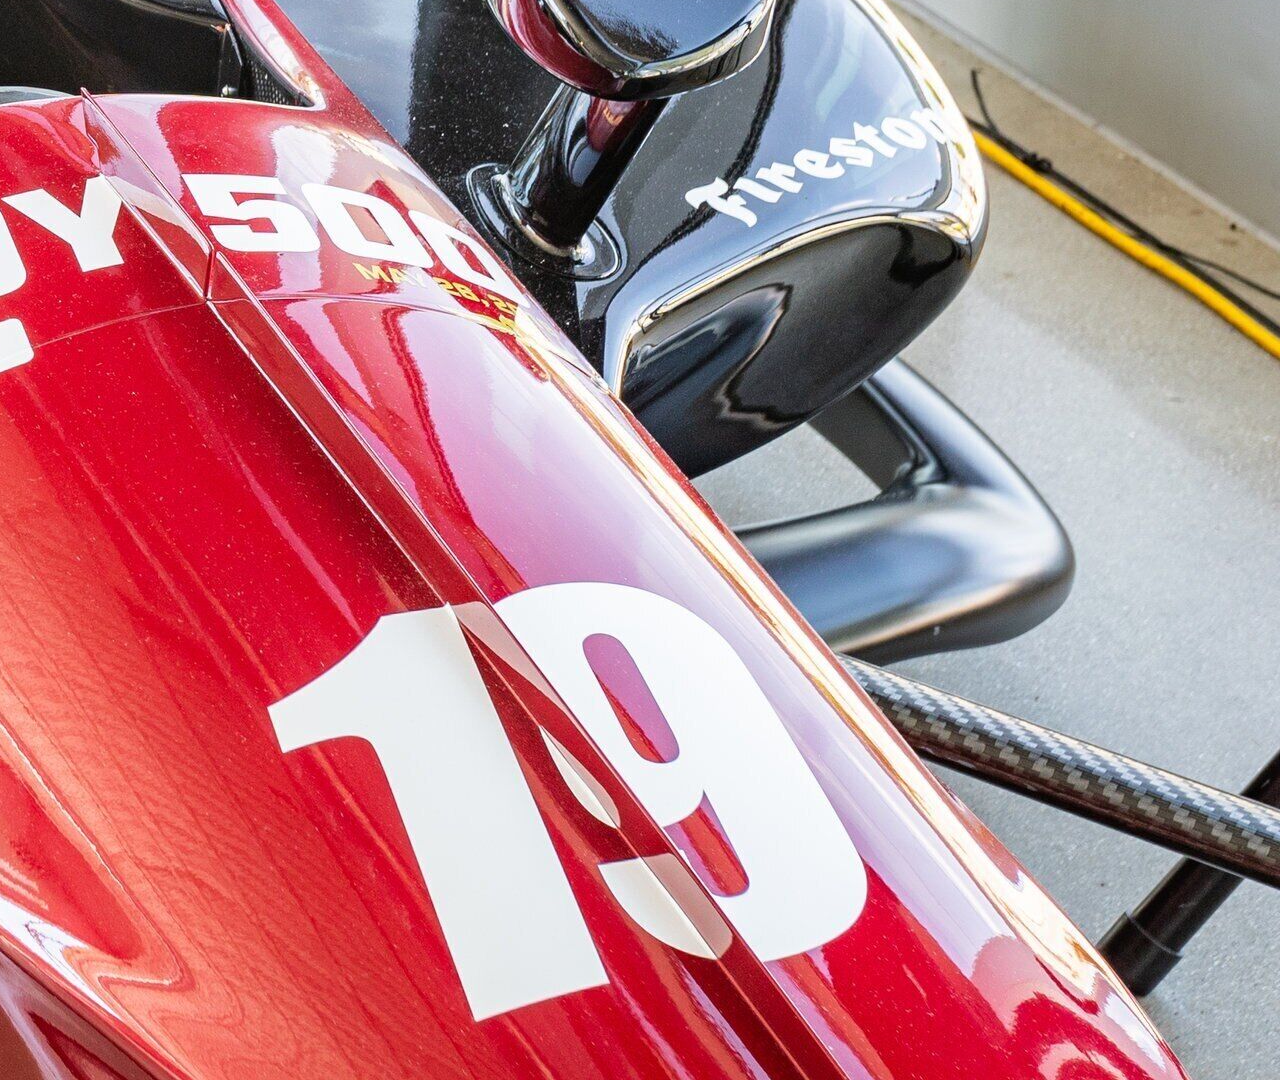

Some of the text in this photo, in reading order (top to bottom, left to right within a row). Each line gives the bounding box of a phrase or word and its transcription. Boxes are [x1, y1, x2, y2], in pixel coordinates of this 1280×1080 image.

[181, 173, 530, 308] 500
[352, 261, 427, 288] MAY
[266, 581, 869, 1023] 19
